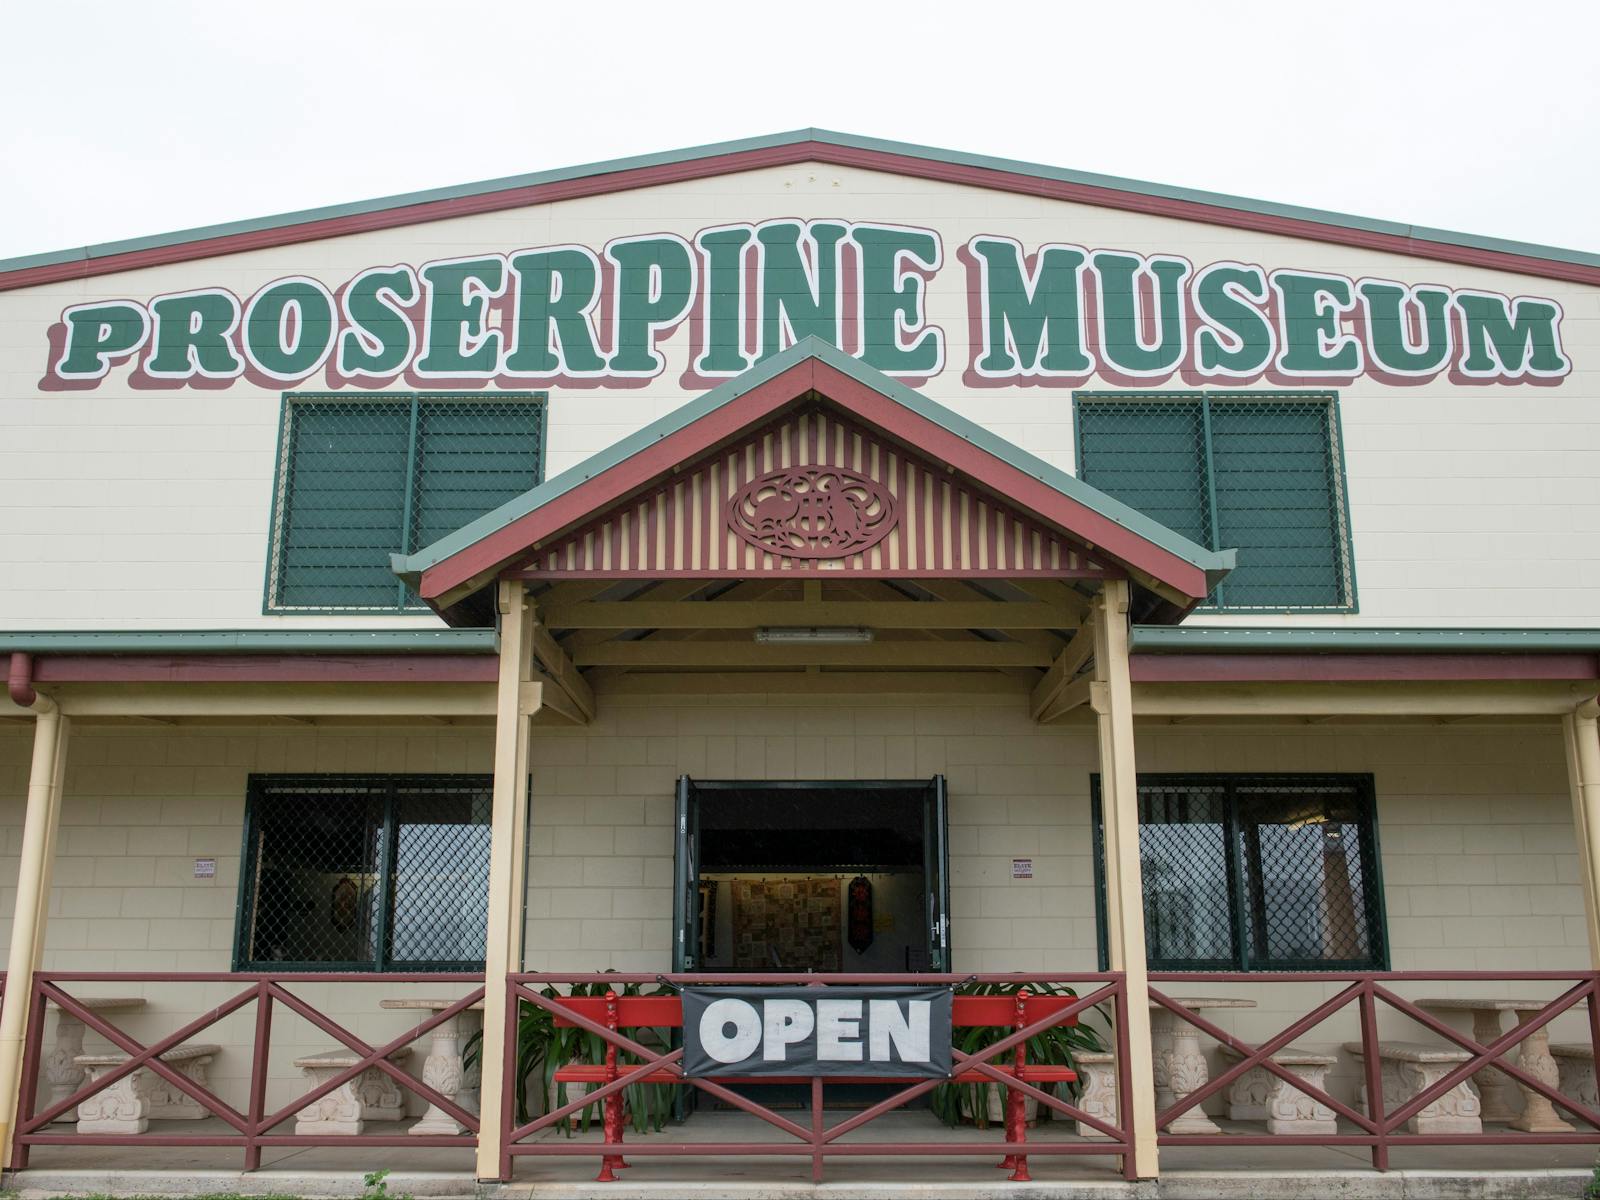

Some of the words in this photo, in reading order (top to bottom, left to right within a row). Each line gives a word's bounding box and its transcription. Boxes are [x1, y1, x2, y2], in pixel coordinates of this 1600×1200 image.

[39, 217, 945, 390] PROSERPINE
[962, 234, 1572, 388] MUSEUM
[699, 998, 931, 1064] OPEN
